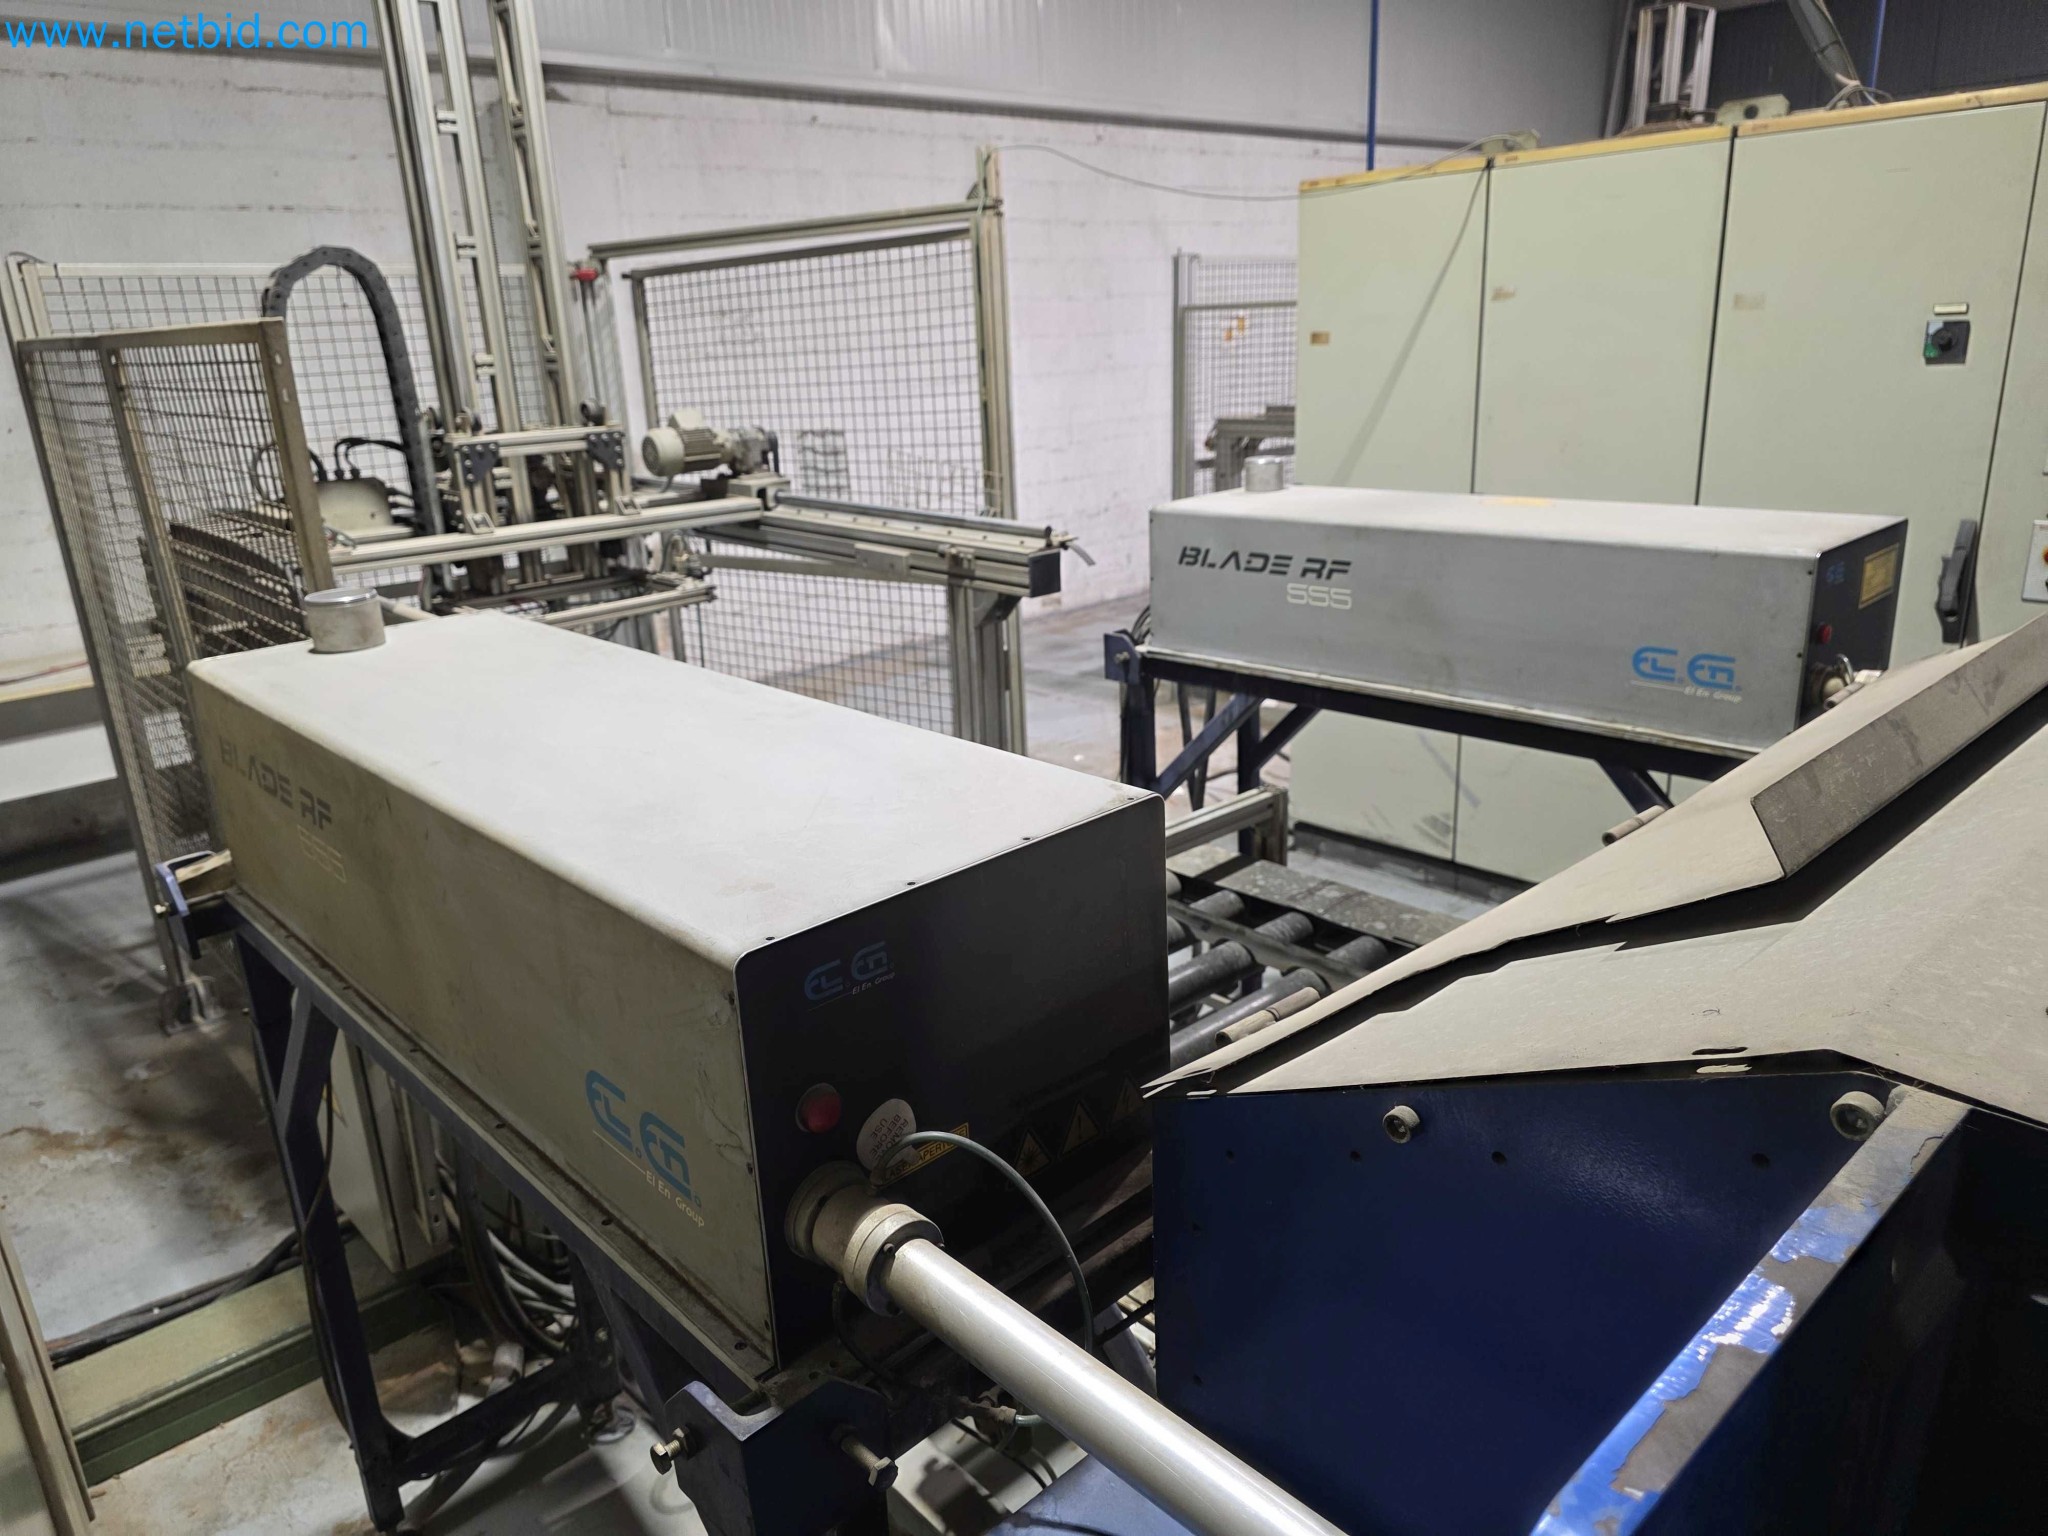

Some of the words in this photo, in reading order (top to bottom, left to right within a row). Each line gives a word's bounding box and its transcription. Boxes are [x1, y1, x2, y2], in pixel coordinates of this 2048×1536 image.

[1178, 546, 1293, 576] BLADE
[1300, 557, 1352, 580] RF
[219, 735, 294, 810] BLADE
[299, 786, 333, 831] RF
[869, 1114, 902, 1158] BEFORE
[870, 1118, 888, 1139] USE
[646, 1170, 656, 1187] El
[658, 1180, 671, 1199] En
[675, 1196, 705, 1228] Group
